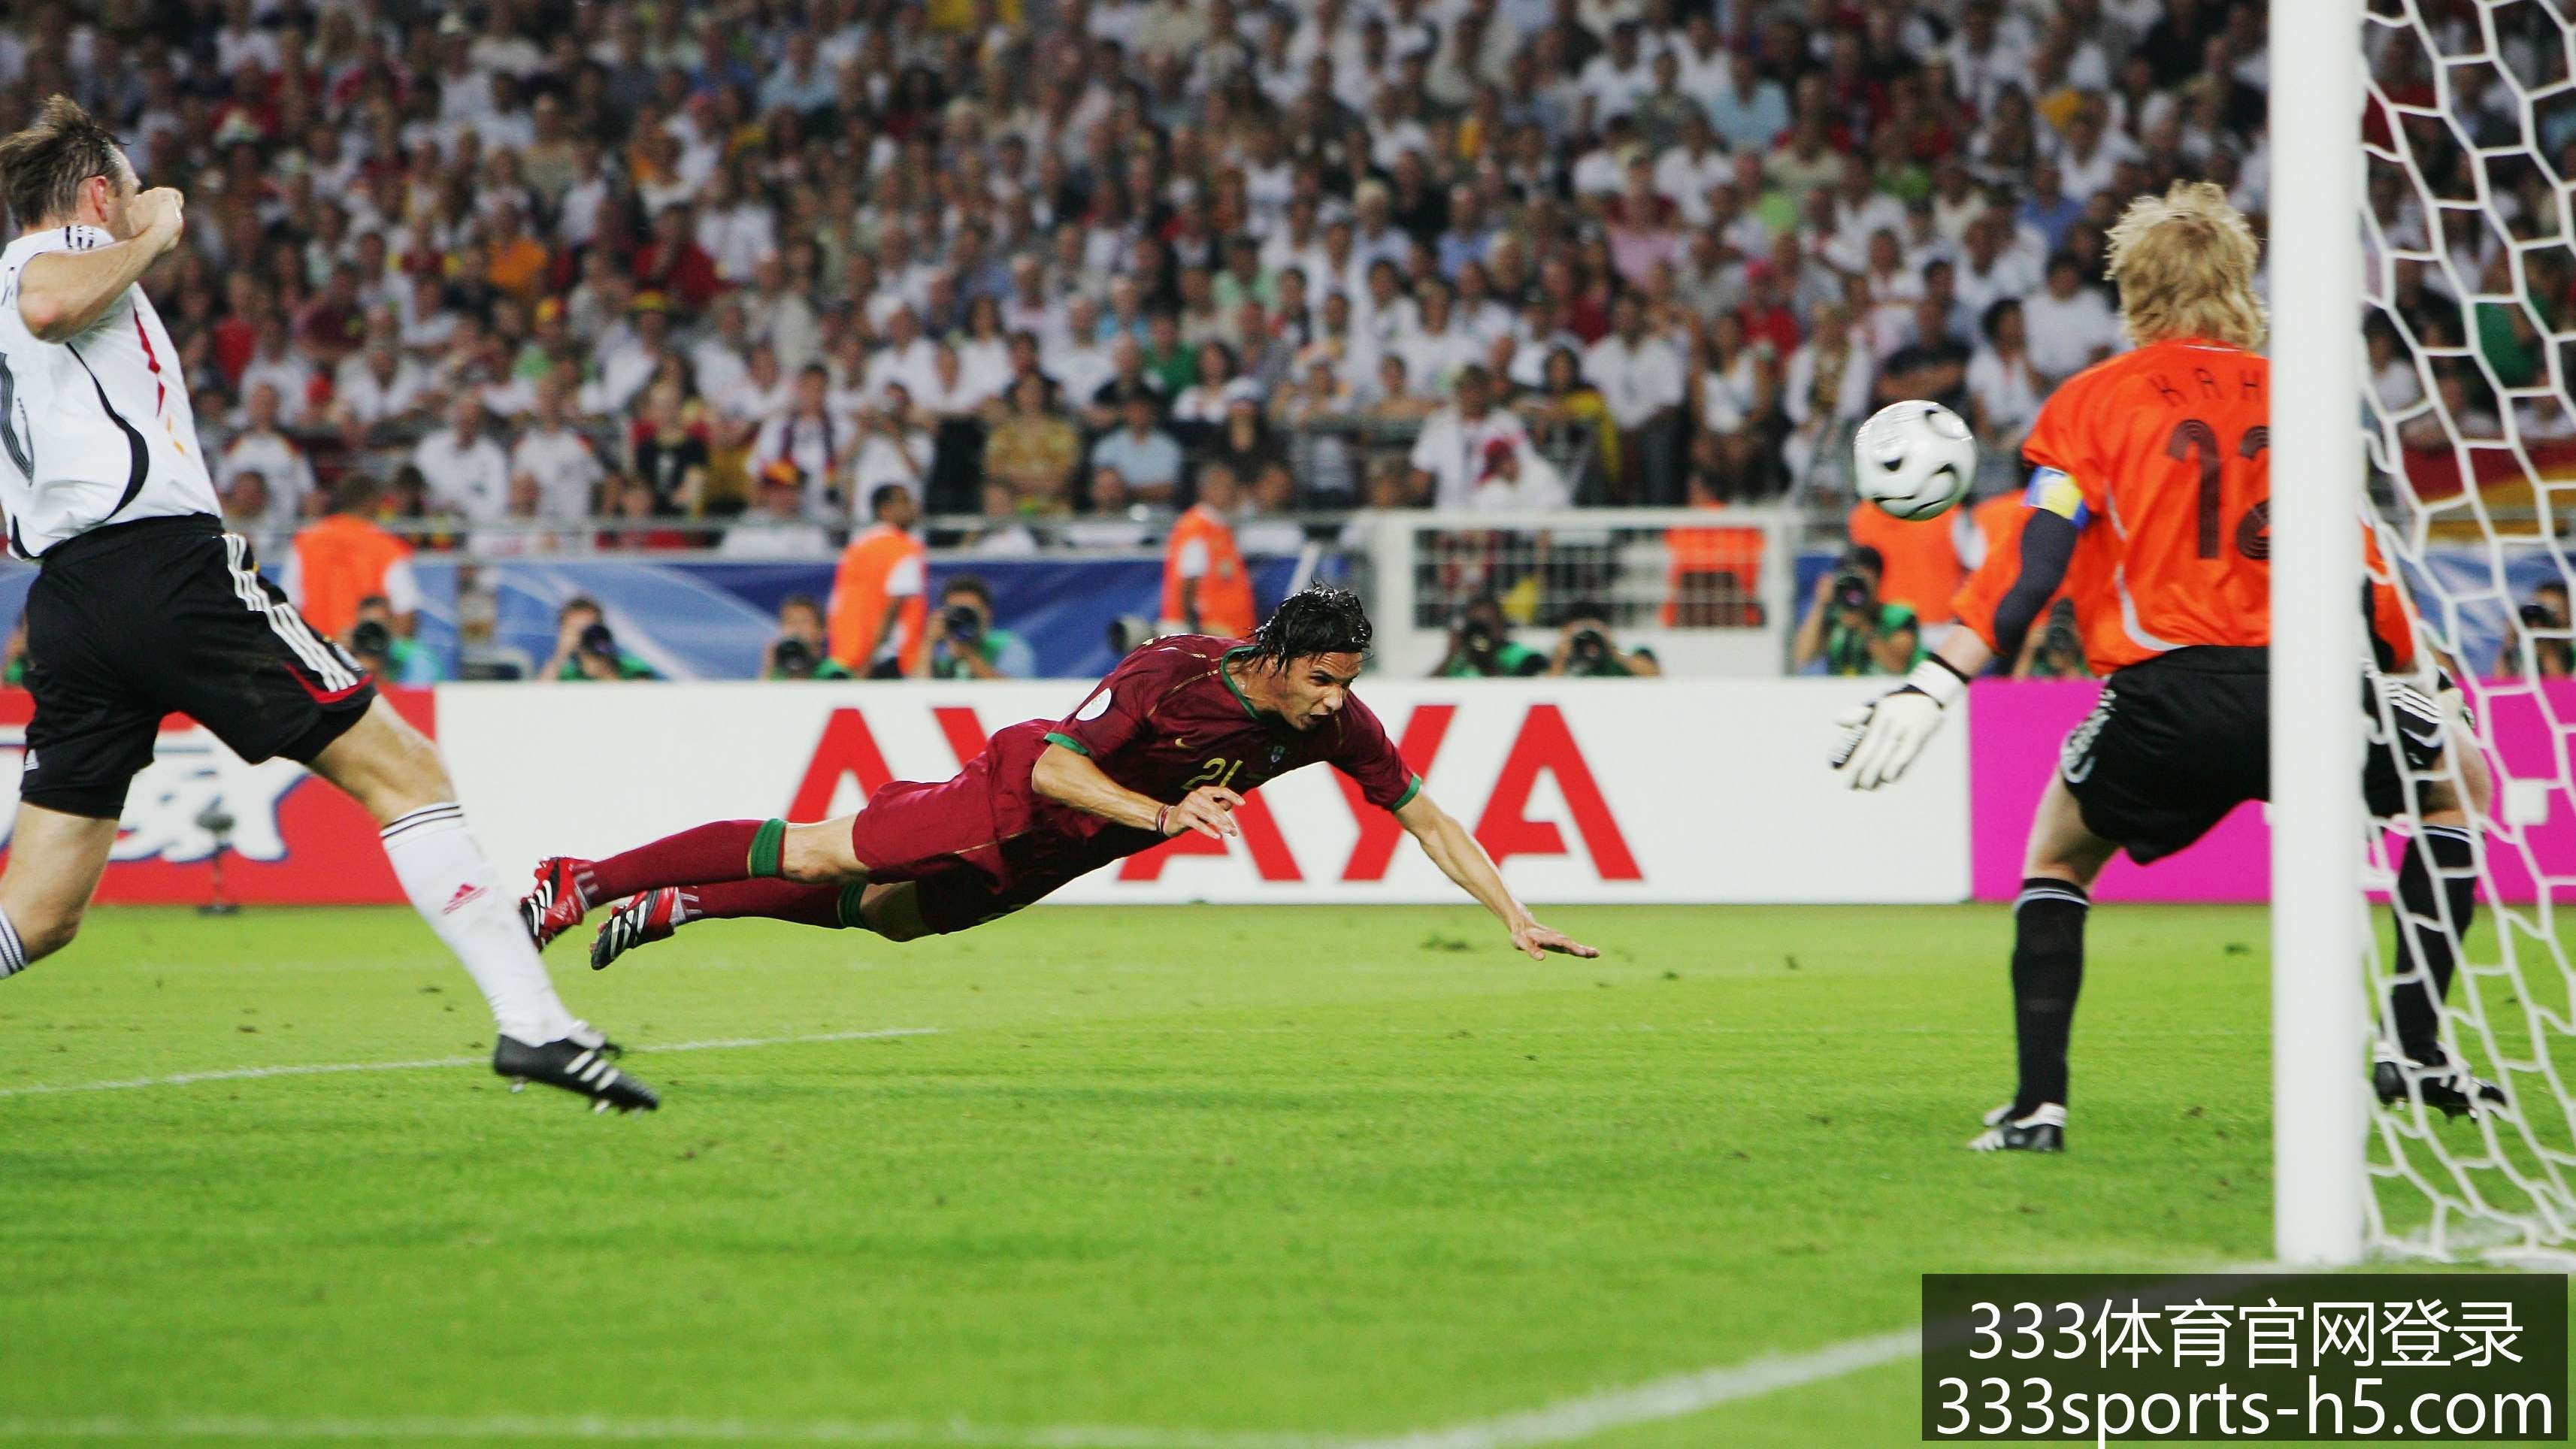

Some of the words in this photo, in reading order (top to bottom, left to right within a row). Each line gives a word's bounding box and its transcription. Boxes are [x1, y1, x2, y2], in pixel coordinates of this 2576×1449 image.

[2149, 366, 2270, 407] KAH
[2166, 418, 2270, 560] 12
[787, 705, 1644, 882] AYA
[1180, 758, 1244, 790] 21
